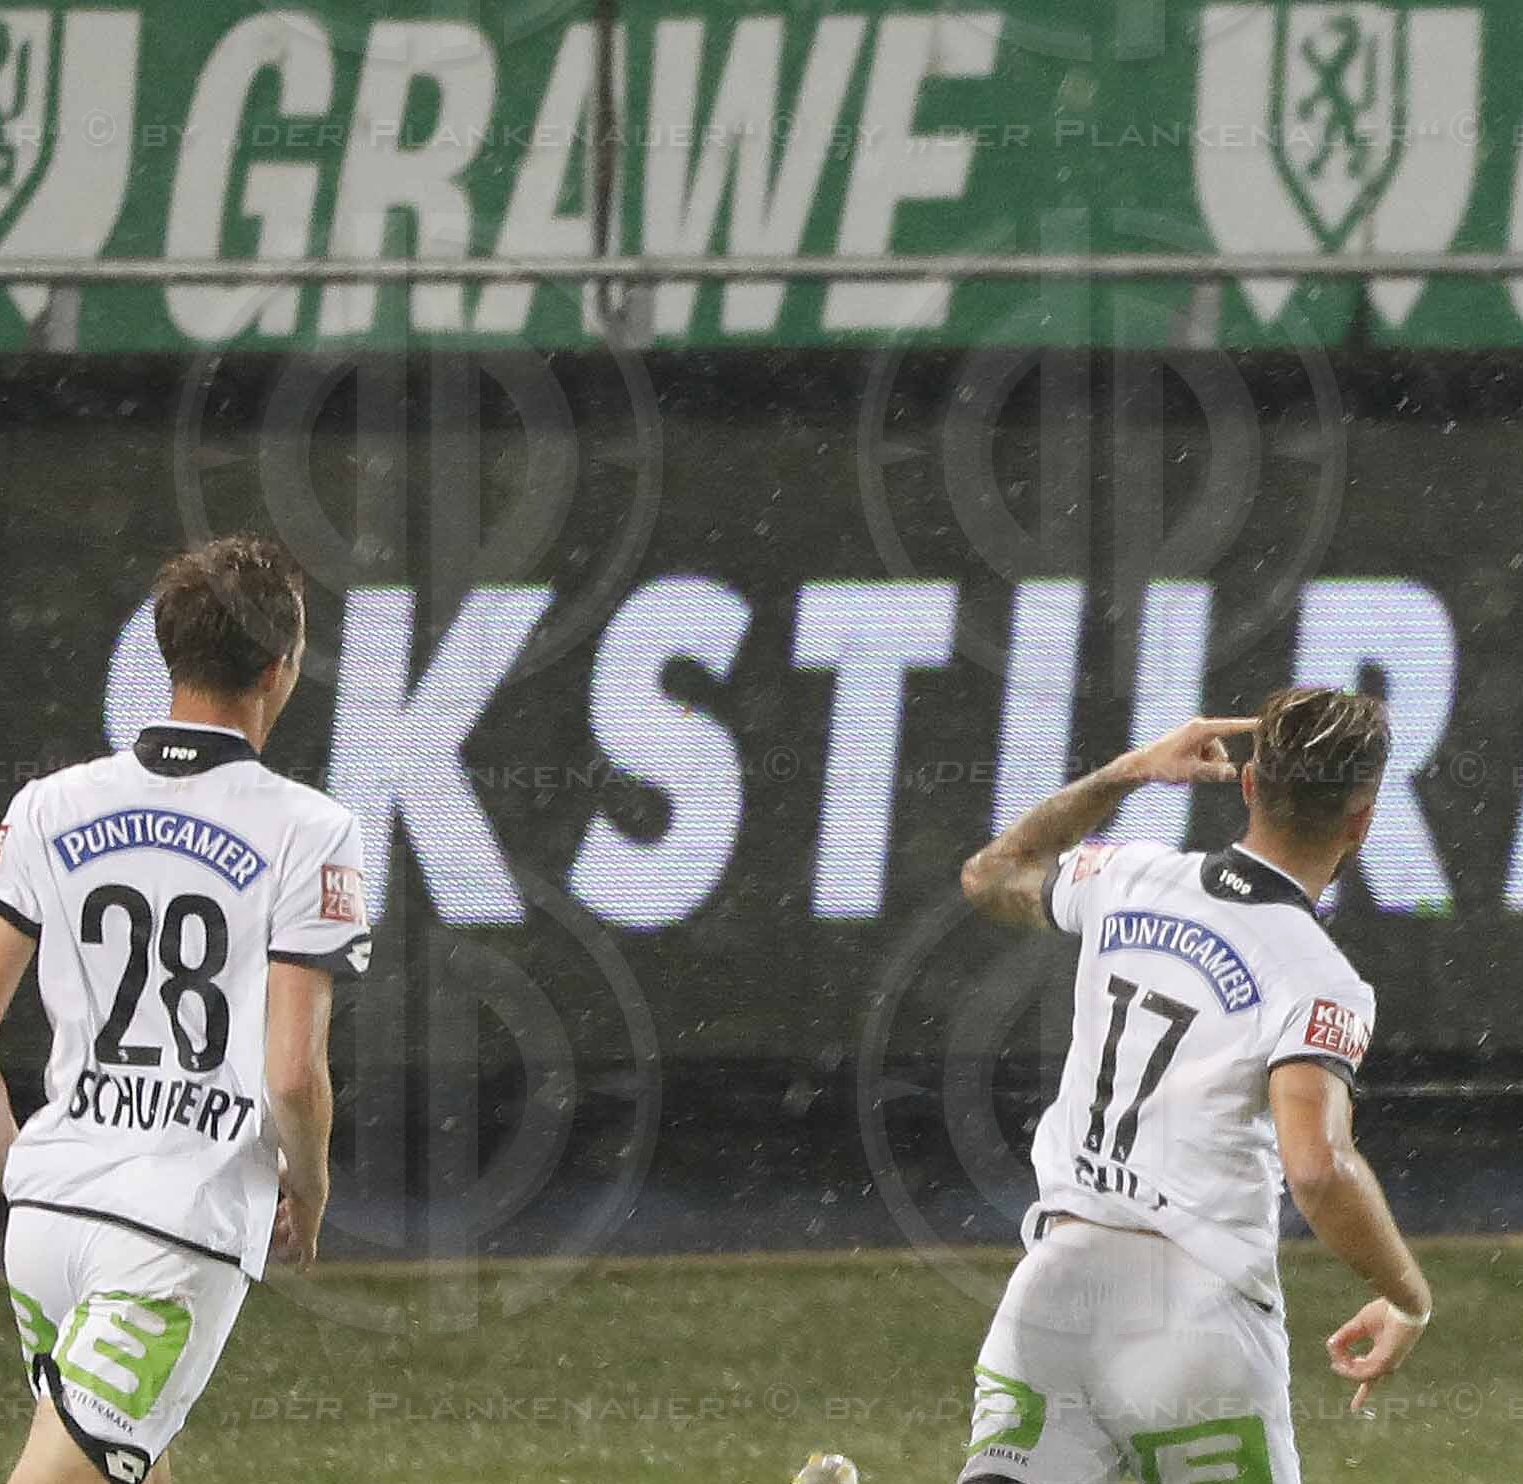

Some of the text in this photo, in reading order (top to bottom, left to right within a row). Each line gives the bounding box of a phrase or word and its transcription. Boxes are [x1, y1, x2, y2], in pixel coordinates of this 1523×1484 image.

[160, 8, 1009, 342] GRAWE
[61, 812, 260, 886] PUNTIGAMER
[80, 884, 230, 1073] 28
[1104, 916, 1254, 1012] PUNTIGAMER
[1085, 973, 1198, 1165] 17
